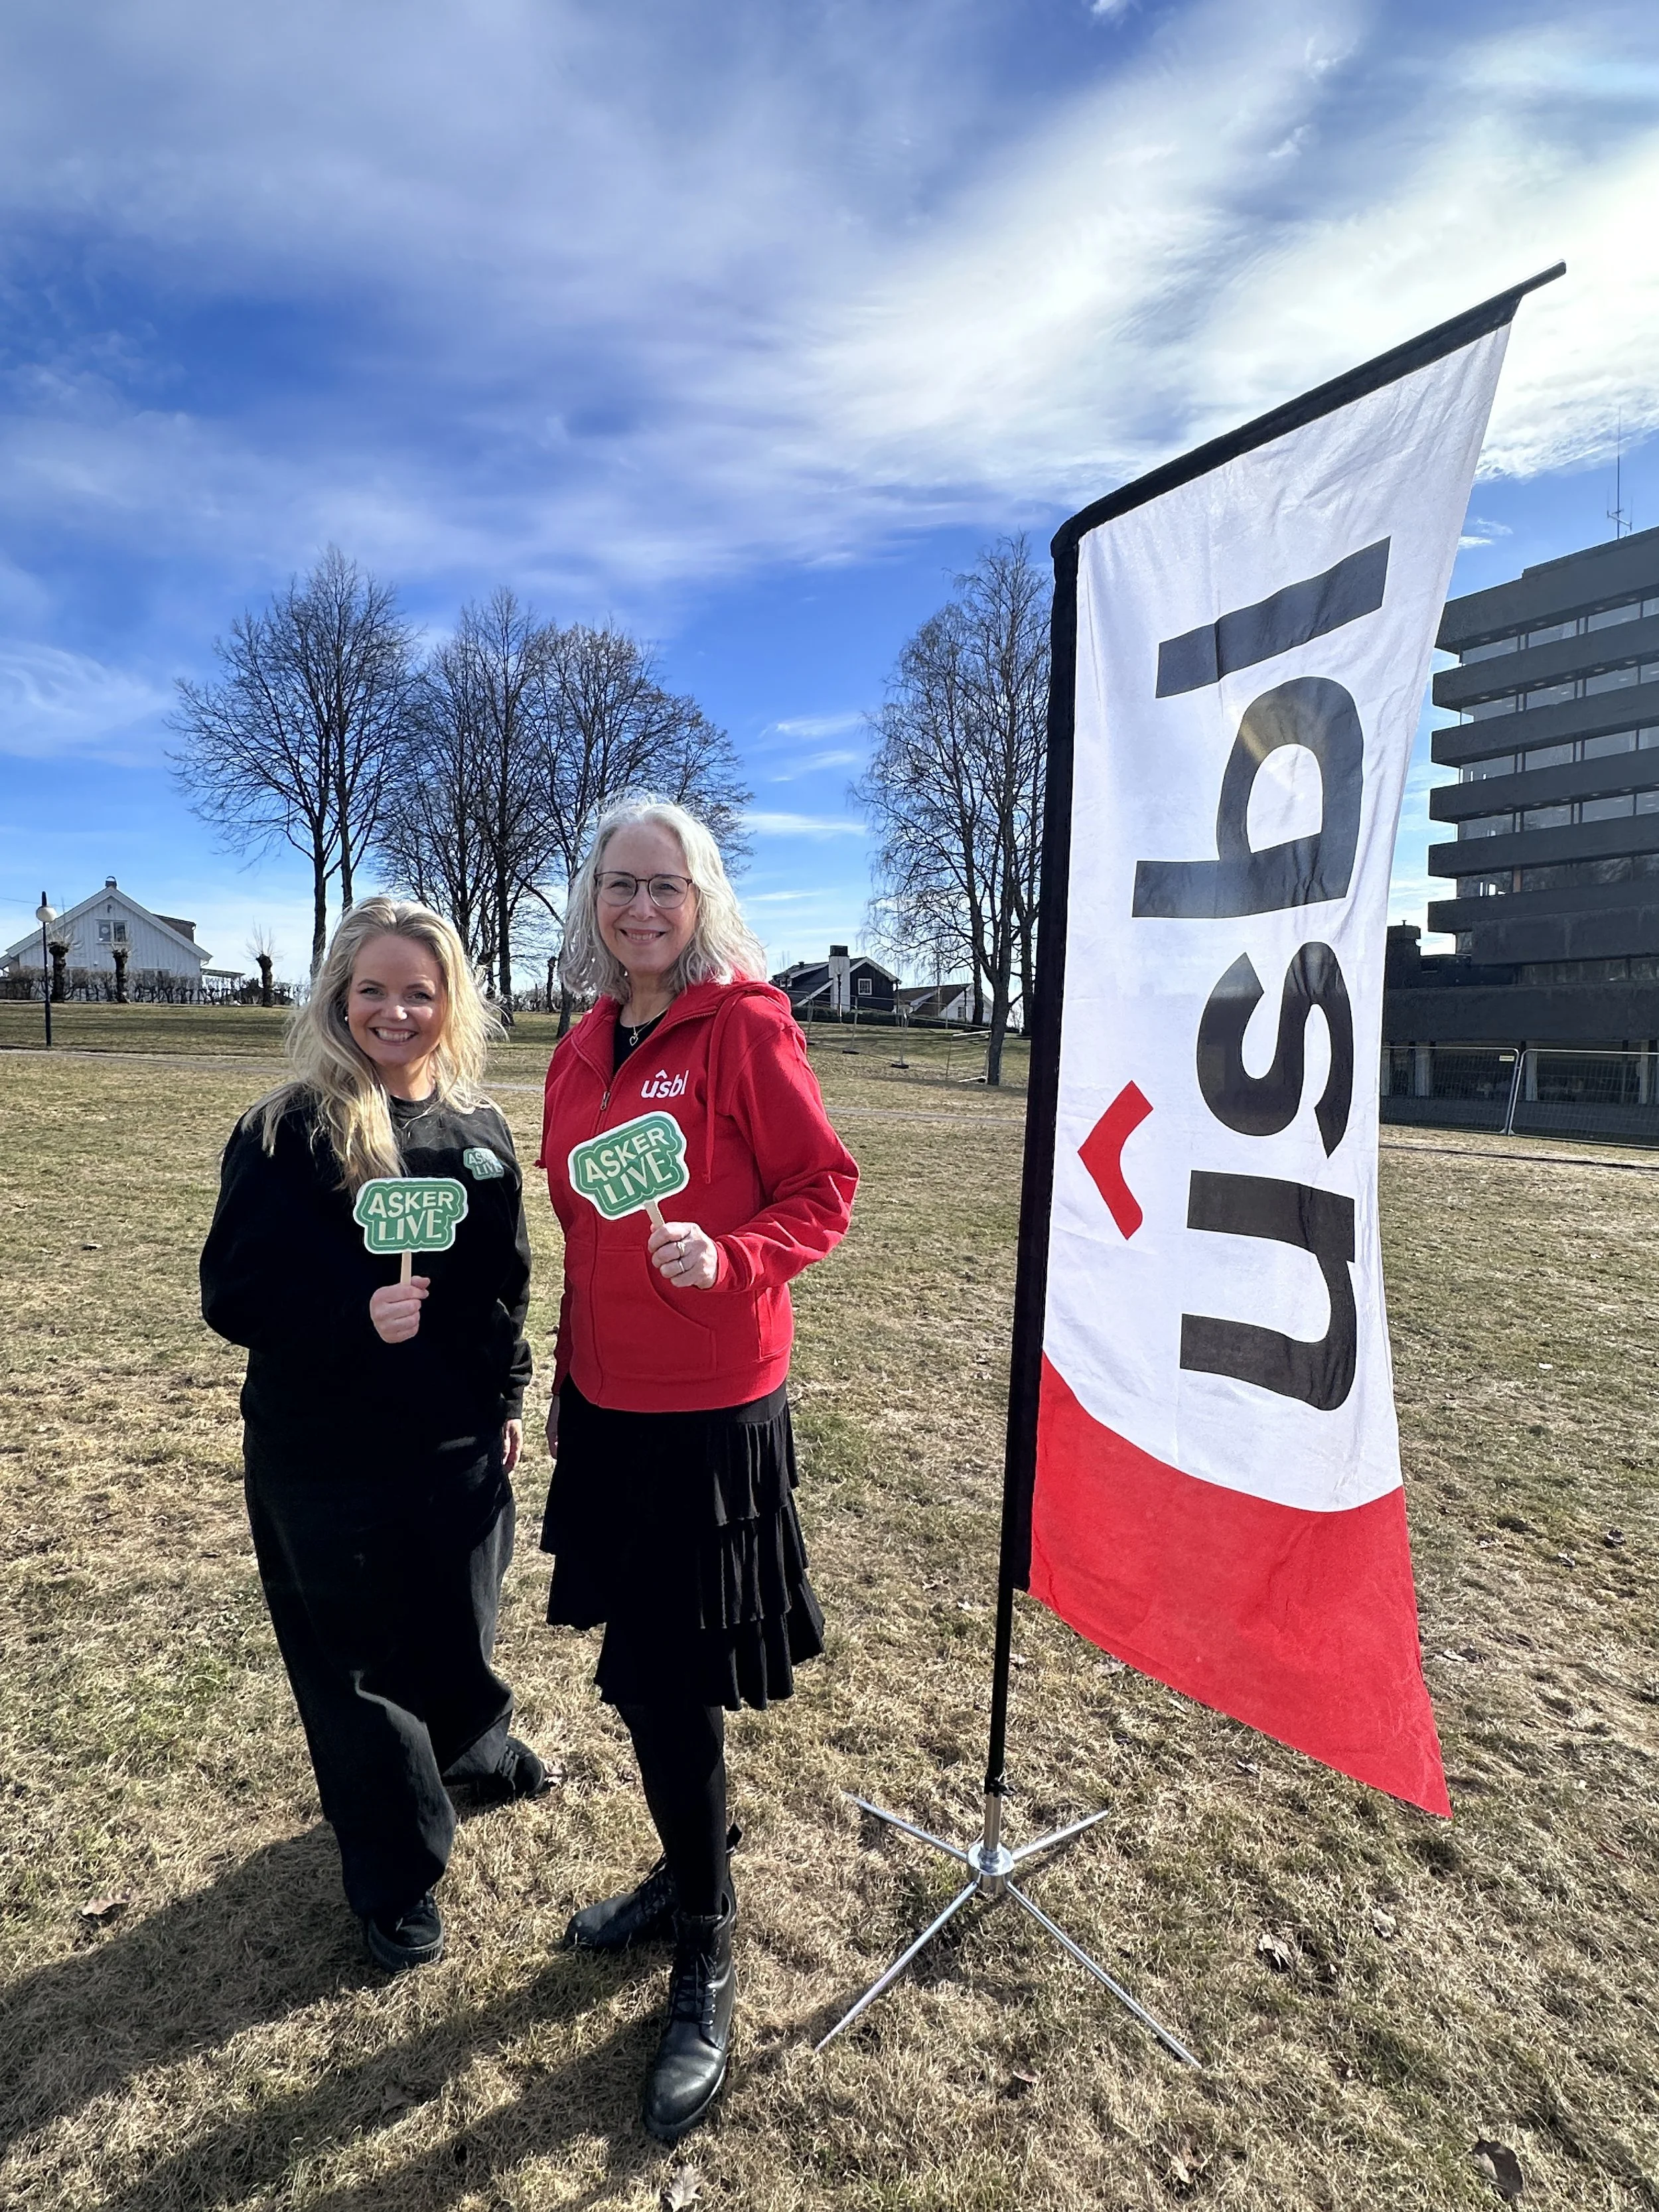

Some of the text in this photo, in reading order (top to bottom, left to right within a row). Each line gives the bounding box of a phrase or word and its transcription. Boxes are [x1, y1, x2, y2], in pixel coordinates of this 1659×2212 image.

[585, 1127, 670, 1183] ASKER
[603, 1148, 672, 1205] LIVE
[368, 1191, 454, 1218] ASKER
[378, 1209, 443, 1241] LIVE
